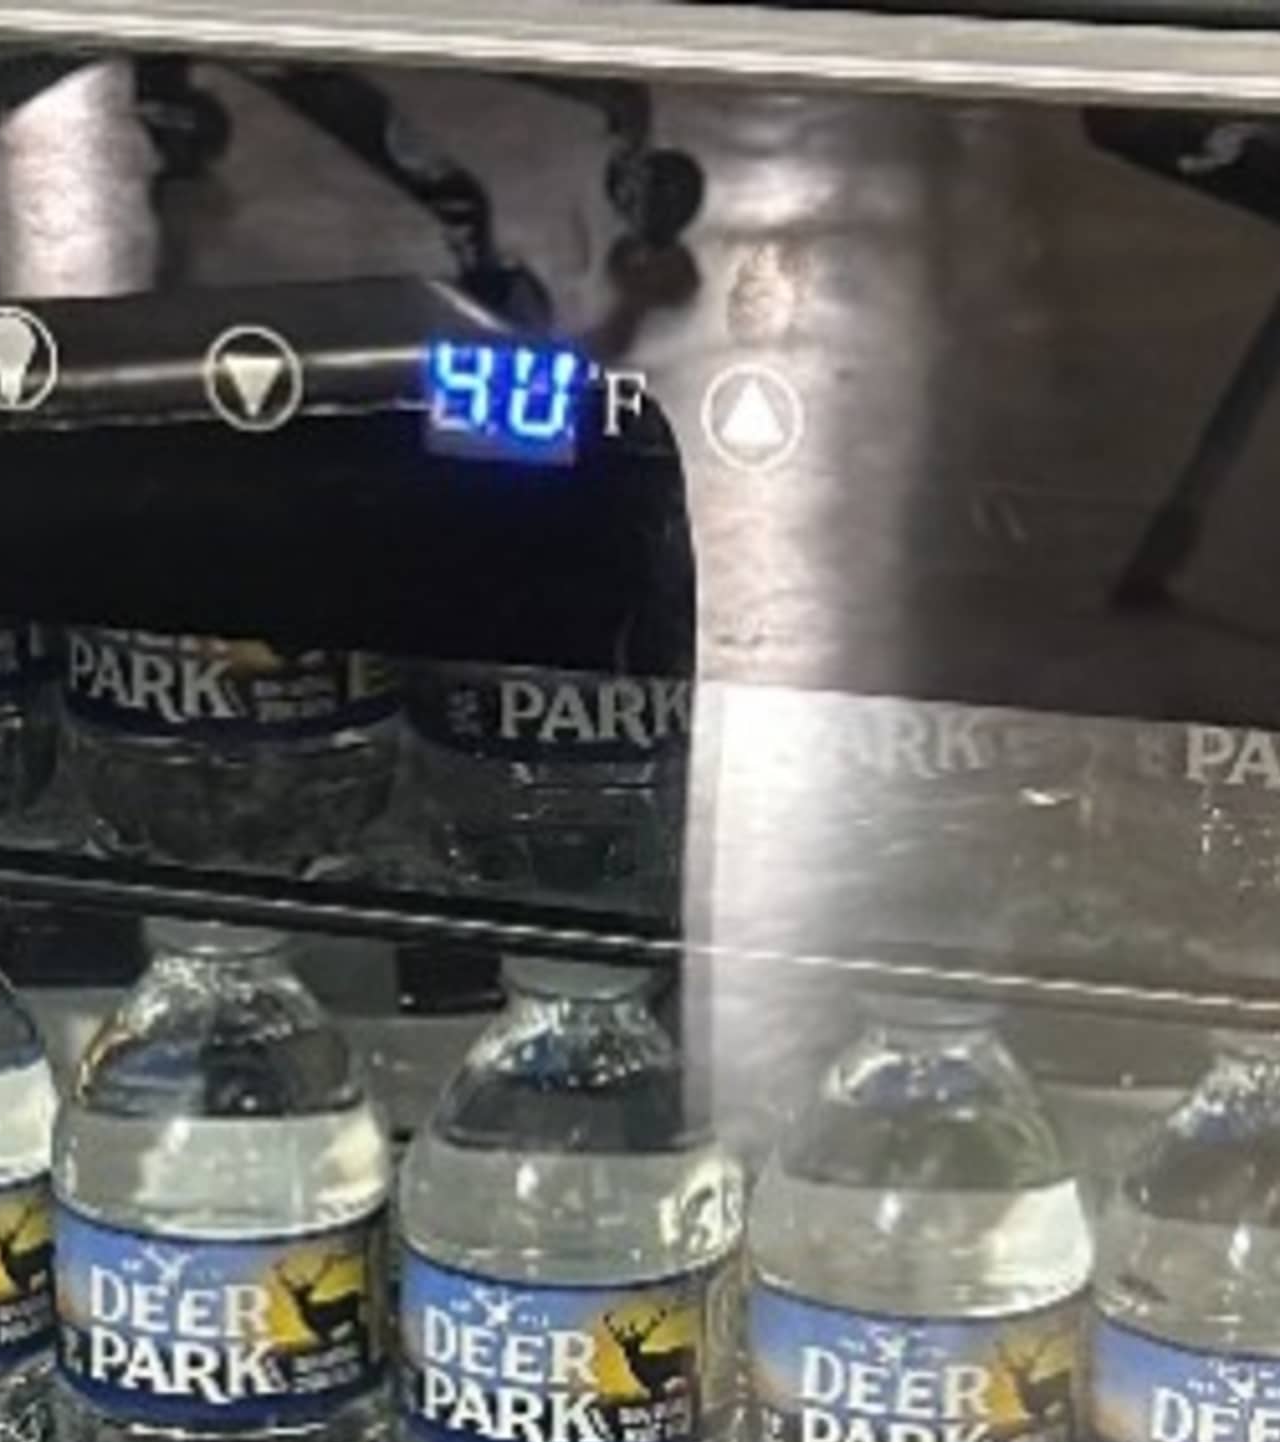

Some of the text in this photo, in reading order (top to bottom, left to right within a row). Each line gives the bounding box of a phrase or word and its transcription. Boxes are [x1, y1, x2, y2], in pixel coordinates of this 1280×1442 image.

[68, 629, 232, 722] PARK
[500, 680, 692, 748] PARK
[90, 1263, 271, 1338] DEER
[90, 1324, 282, 1405] PARK
[423, 1304, 599, 1384] DEER
[801, 1346, 993, 1420] DEER
